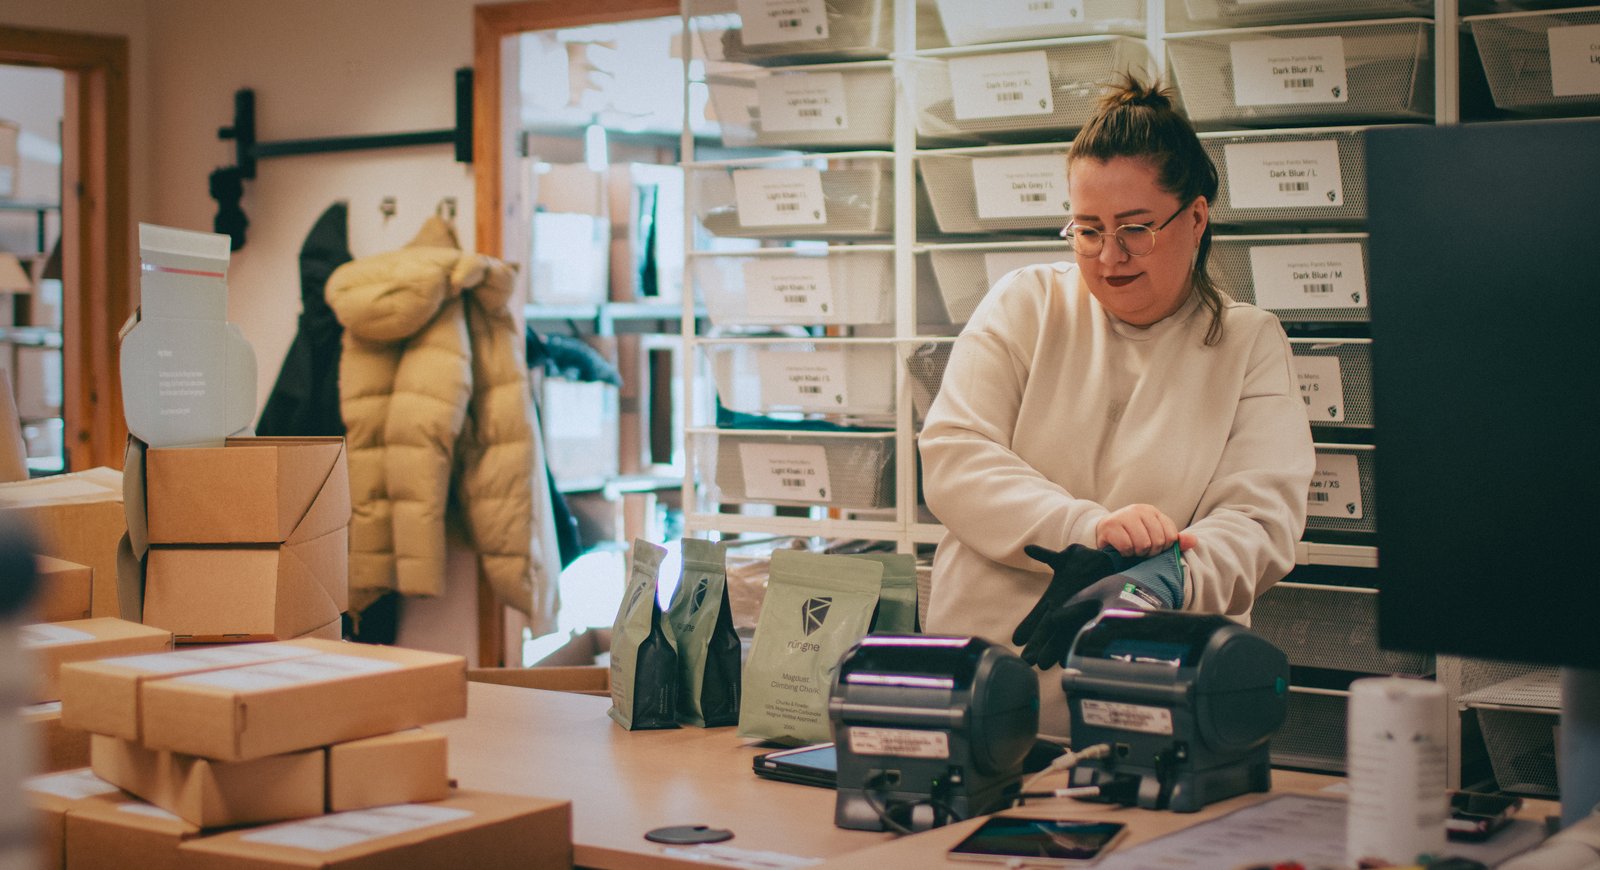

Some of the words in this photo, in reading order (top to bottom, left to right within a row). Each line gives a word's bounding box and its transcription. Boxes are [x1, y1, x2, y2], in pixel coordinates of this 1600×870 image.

[1272, 66, 1289, 75] Dark
[1291, 66, 1307, 74] Blue
[1315, 65, 1324, 73] XL
[1270, 170, 1286, 178] Dark
[1289, 169, 1305, 177] Blue
[1012, 182, 1027, 190] Dark
[1293, 272, 1309, 280] Dark
[1312, 271, 1328, 279] Blue
[1335, 271, 1343, 279] M
[1313, 383, 1320, 392] S
[1329, 480, 1340, 489] XS
[771, 680, 798, 692] Climbing
